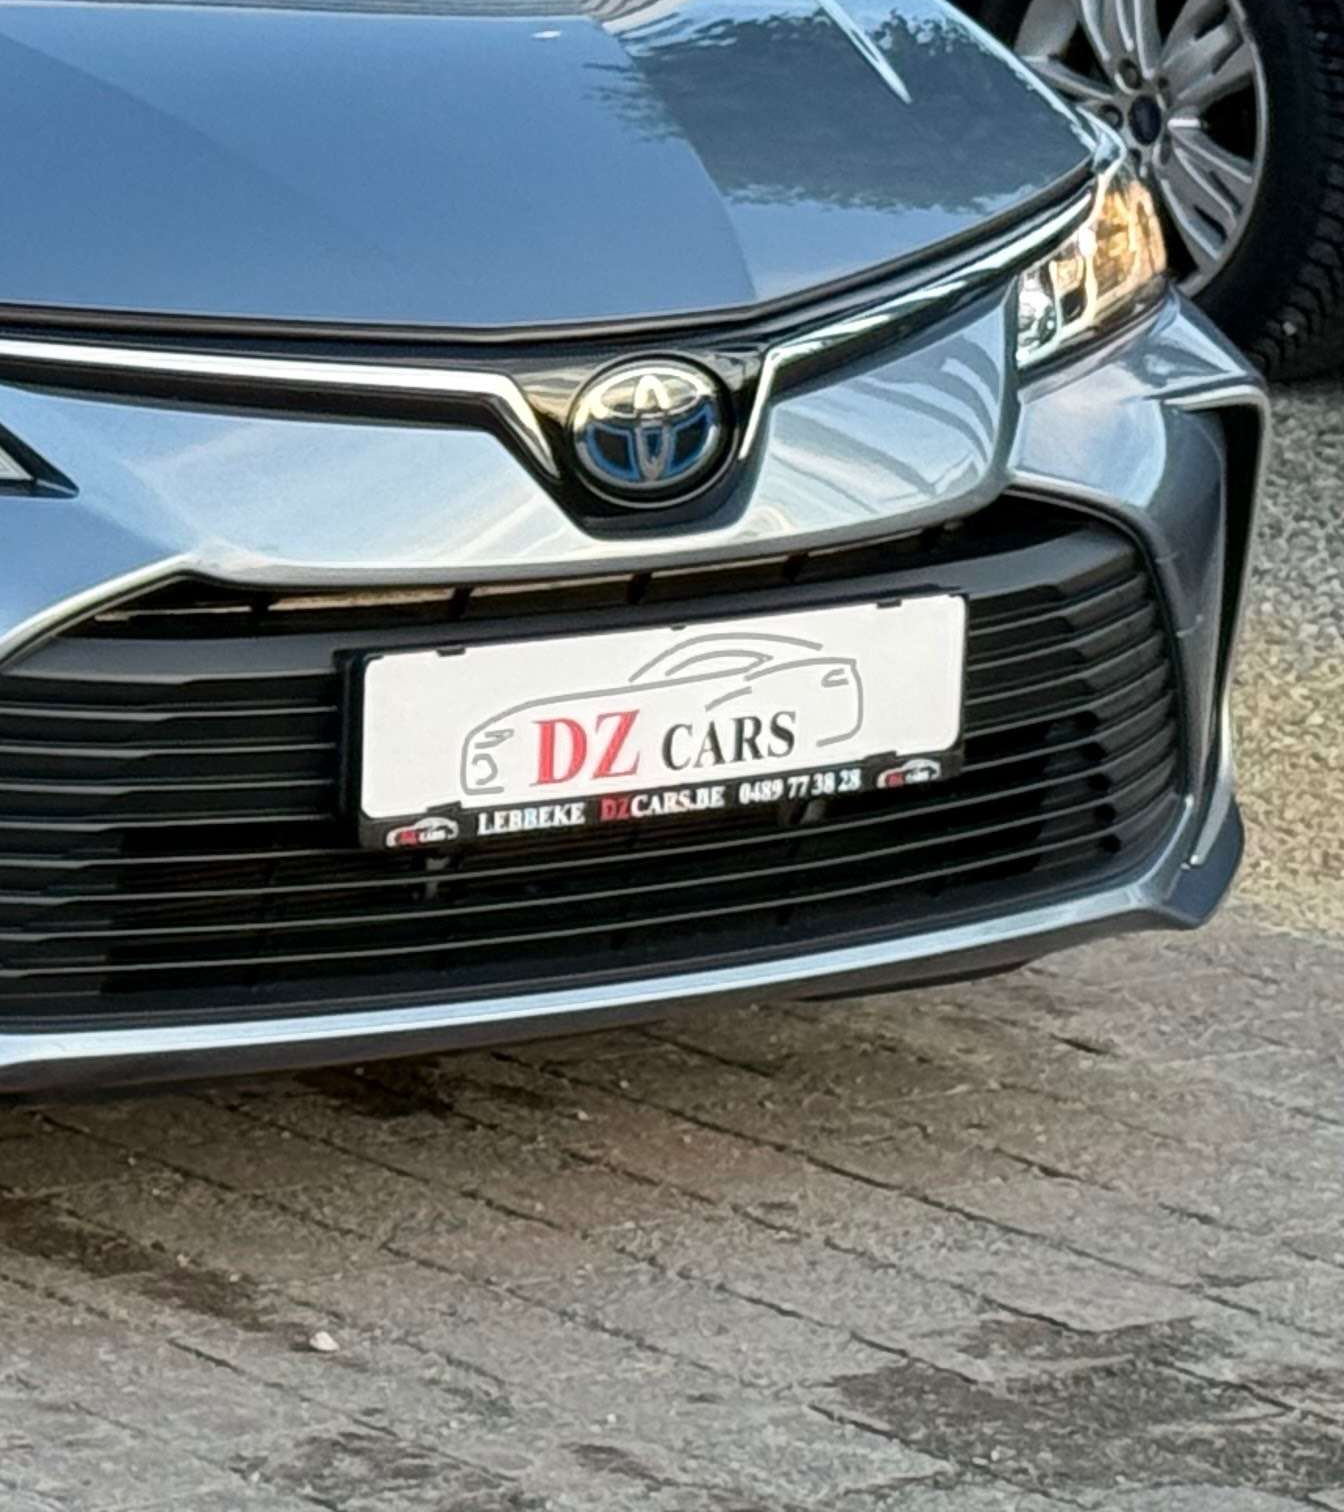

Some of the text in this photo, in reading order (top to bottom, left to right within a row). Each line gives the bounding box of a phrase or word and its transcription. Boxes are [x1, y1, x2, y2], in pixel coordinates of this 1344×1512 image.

[529, 709, 797, 787] DZ CARS
[477, 801, 586, 836] LEBBEKE
[738, 777, 785, 805] 0489
[787, 774, 811, 800] 77
